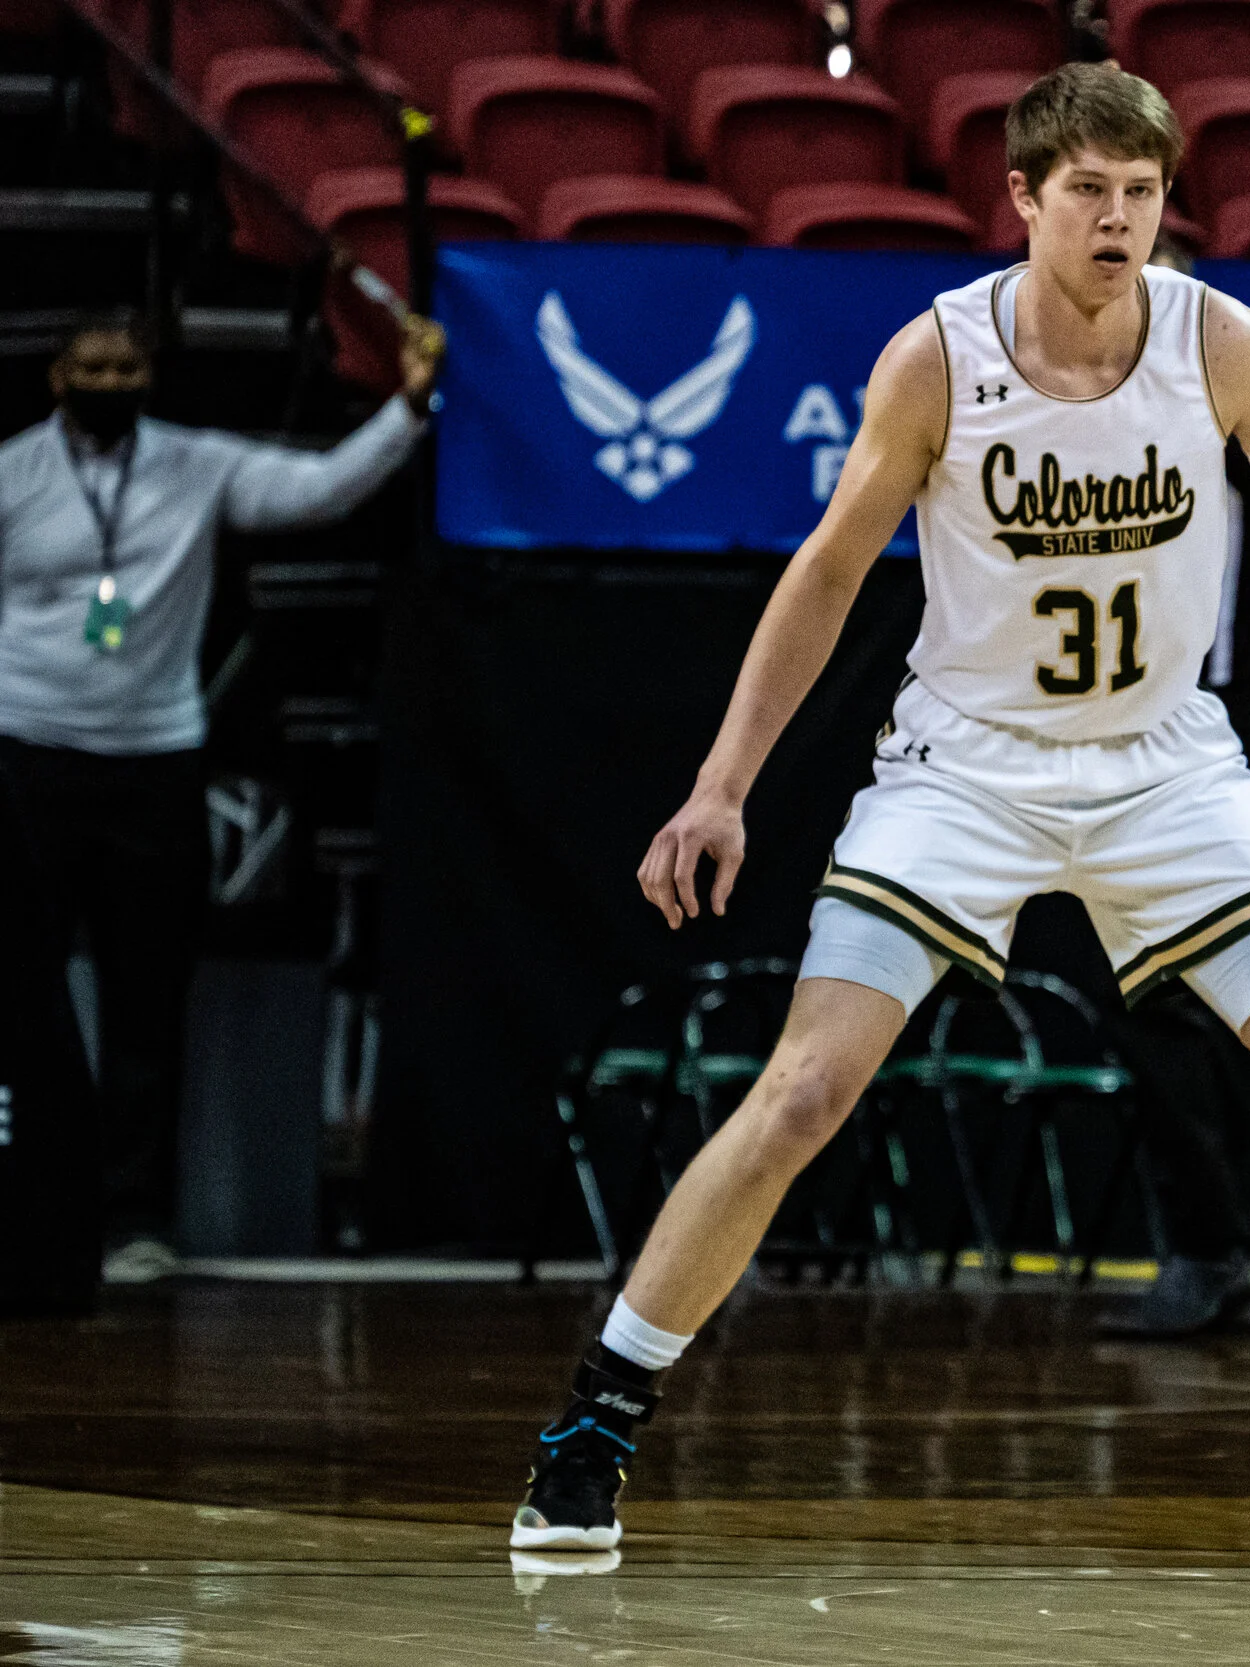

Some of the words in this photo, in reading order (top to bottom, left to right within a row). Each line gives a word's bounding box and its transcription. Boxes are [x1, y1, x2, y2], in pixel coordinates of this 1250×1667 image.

[981, 442, 1195, 528] Colorado
[1042, 528, 1100, 555] STATE
[1110, 526, 1155, 549] UNIV
[1033, 578, 1148, 697] 31
